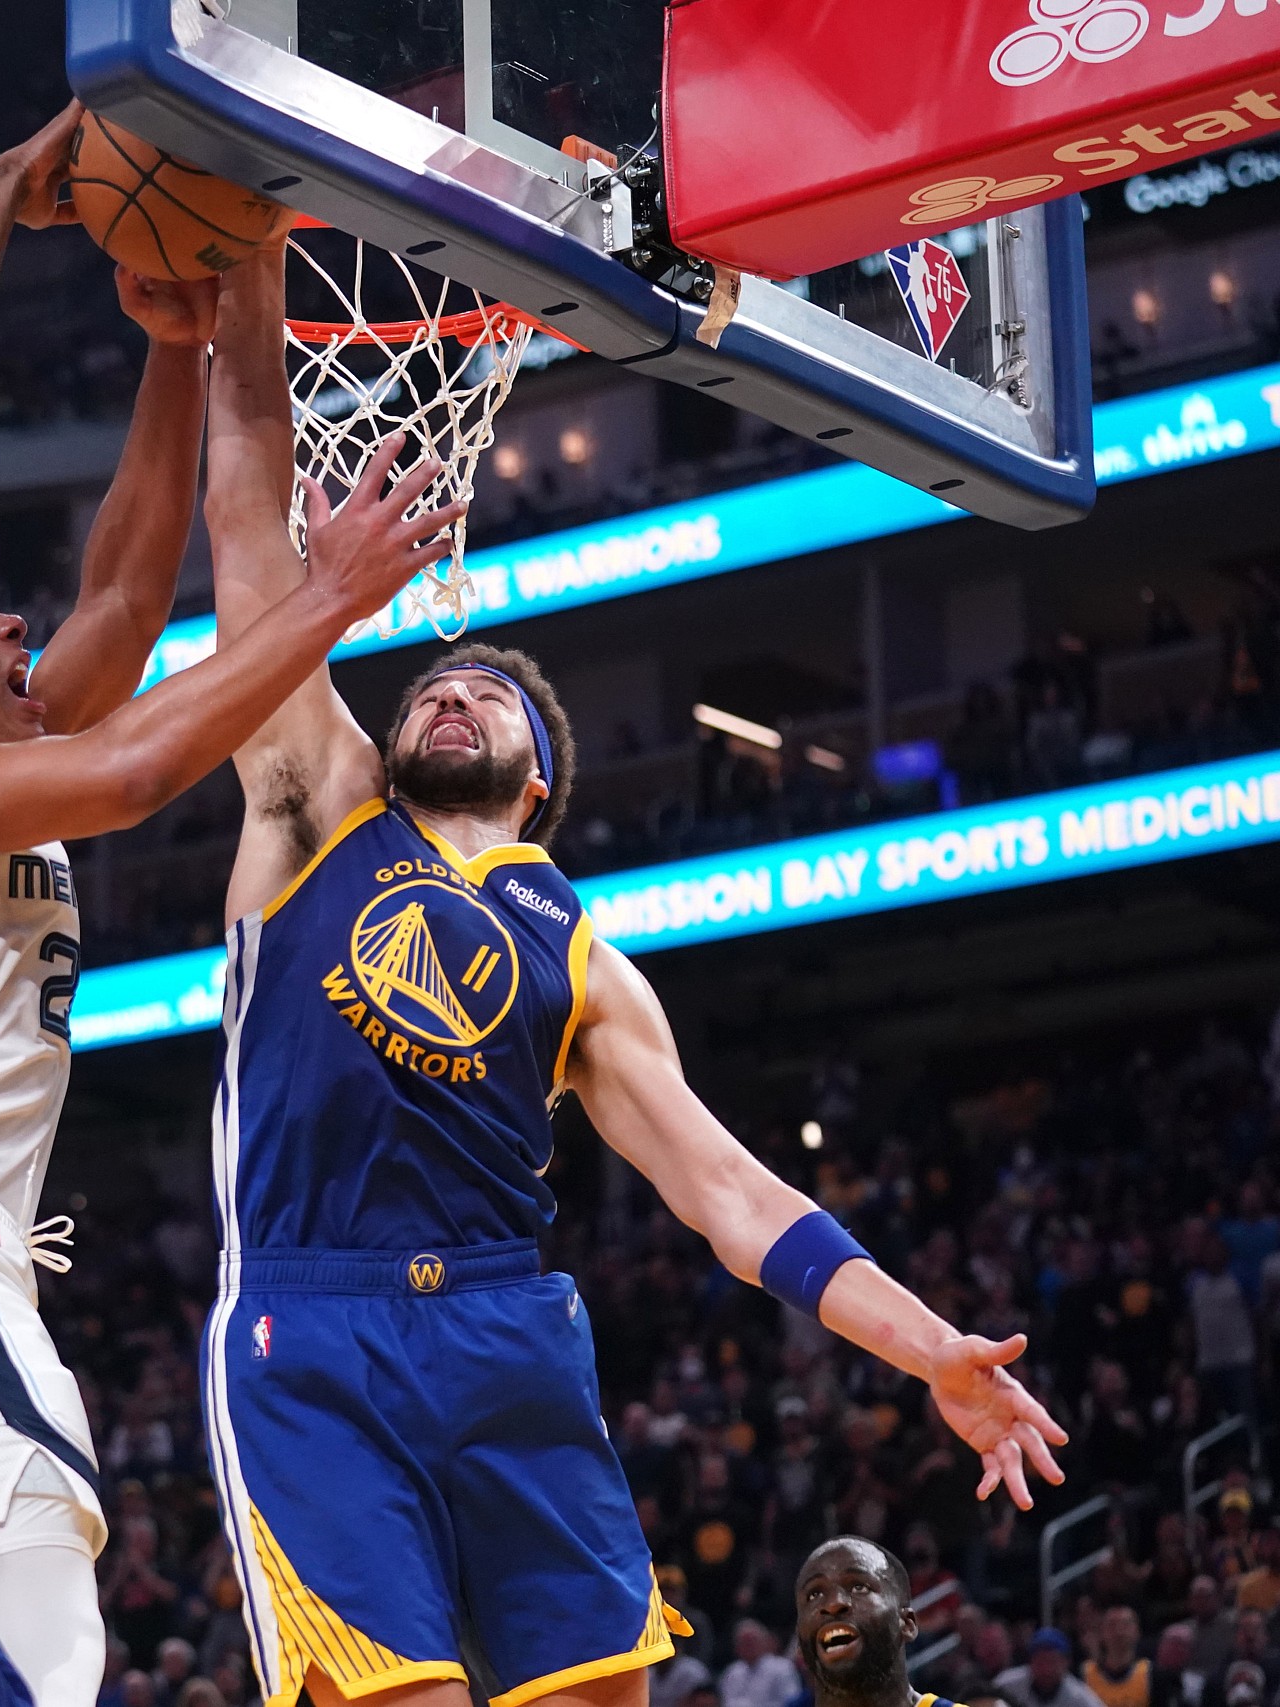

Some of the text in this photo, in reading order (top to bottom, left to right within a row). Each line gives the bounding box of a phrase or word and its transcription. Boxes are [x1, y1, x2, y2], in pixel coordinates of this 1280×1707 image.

[1053, 89, 1280, 176] Stat
[934, 262, 952, 304] 75
[512, 512, 722, 601] WARRIORS
[9, 854, 78, 909] ME
[375, 858, 478, 896] GOLDEN
[589, 771, 1280, 940] MISSION BAY SPORTS MEDICINE
[504, 878, 570, 926] Rakuten
[460, 944, 501, 993] 11
[321, 963, 487, 1083] WARRIORS
[409, 1263, 444, 1287] W
